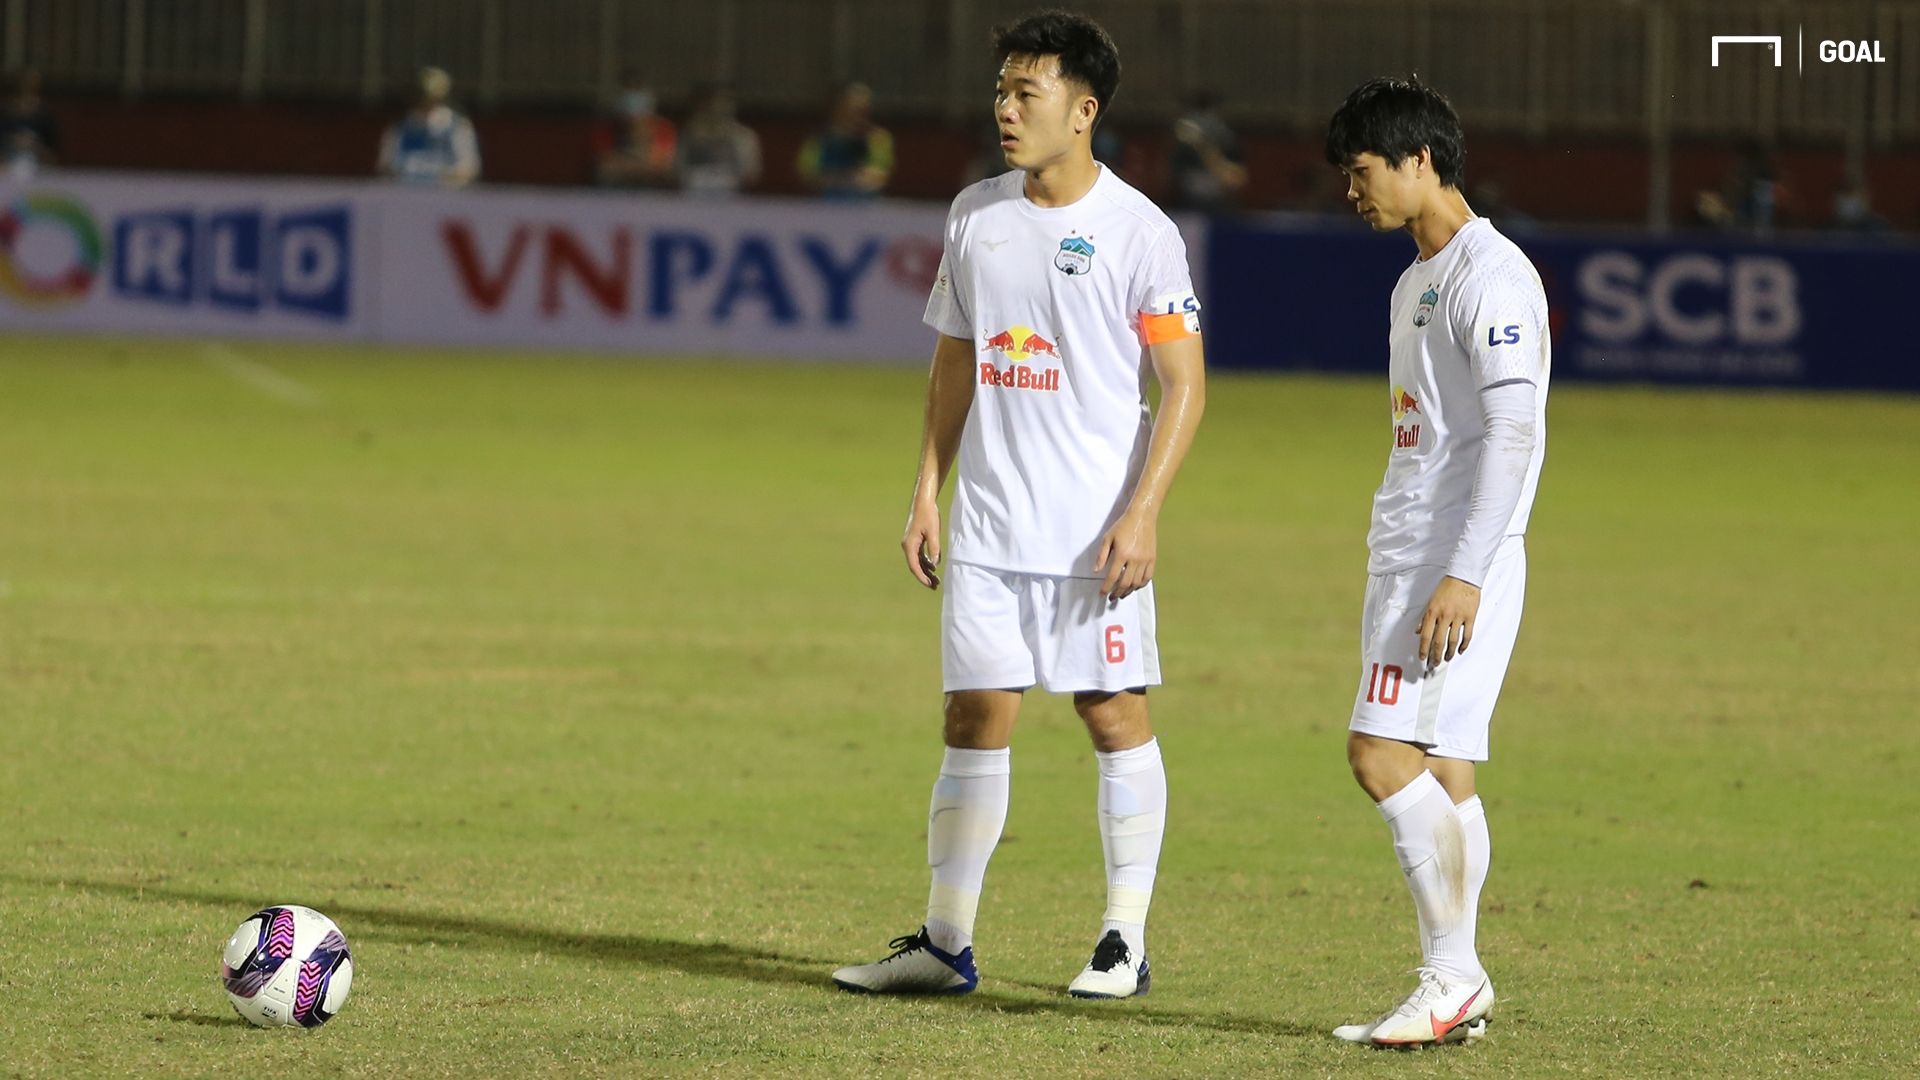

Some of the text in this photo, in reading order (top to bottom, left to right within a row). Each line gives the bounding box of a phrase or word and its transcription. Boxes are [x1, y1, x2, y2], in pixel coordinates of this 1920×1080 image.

[438, 216, 884, 326] VNPAY
[1577, 250, 1803, 345] SCB
[1488, 324, 1521, 347] LS
[980, 362, 1060, 391] Red Bull
[1105, 624, 1126, 664] 6
[1366, 662, 1403, 706] 10
